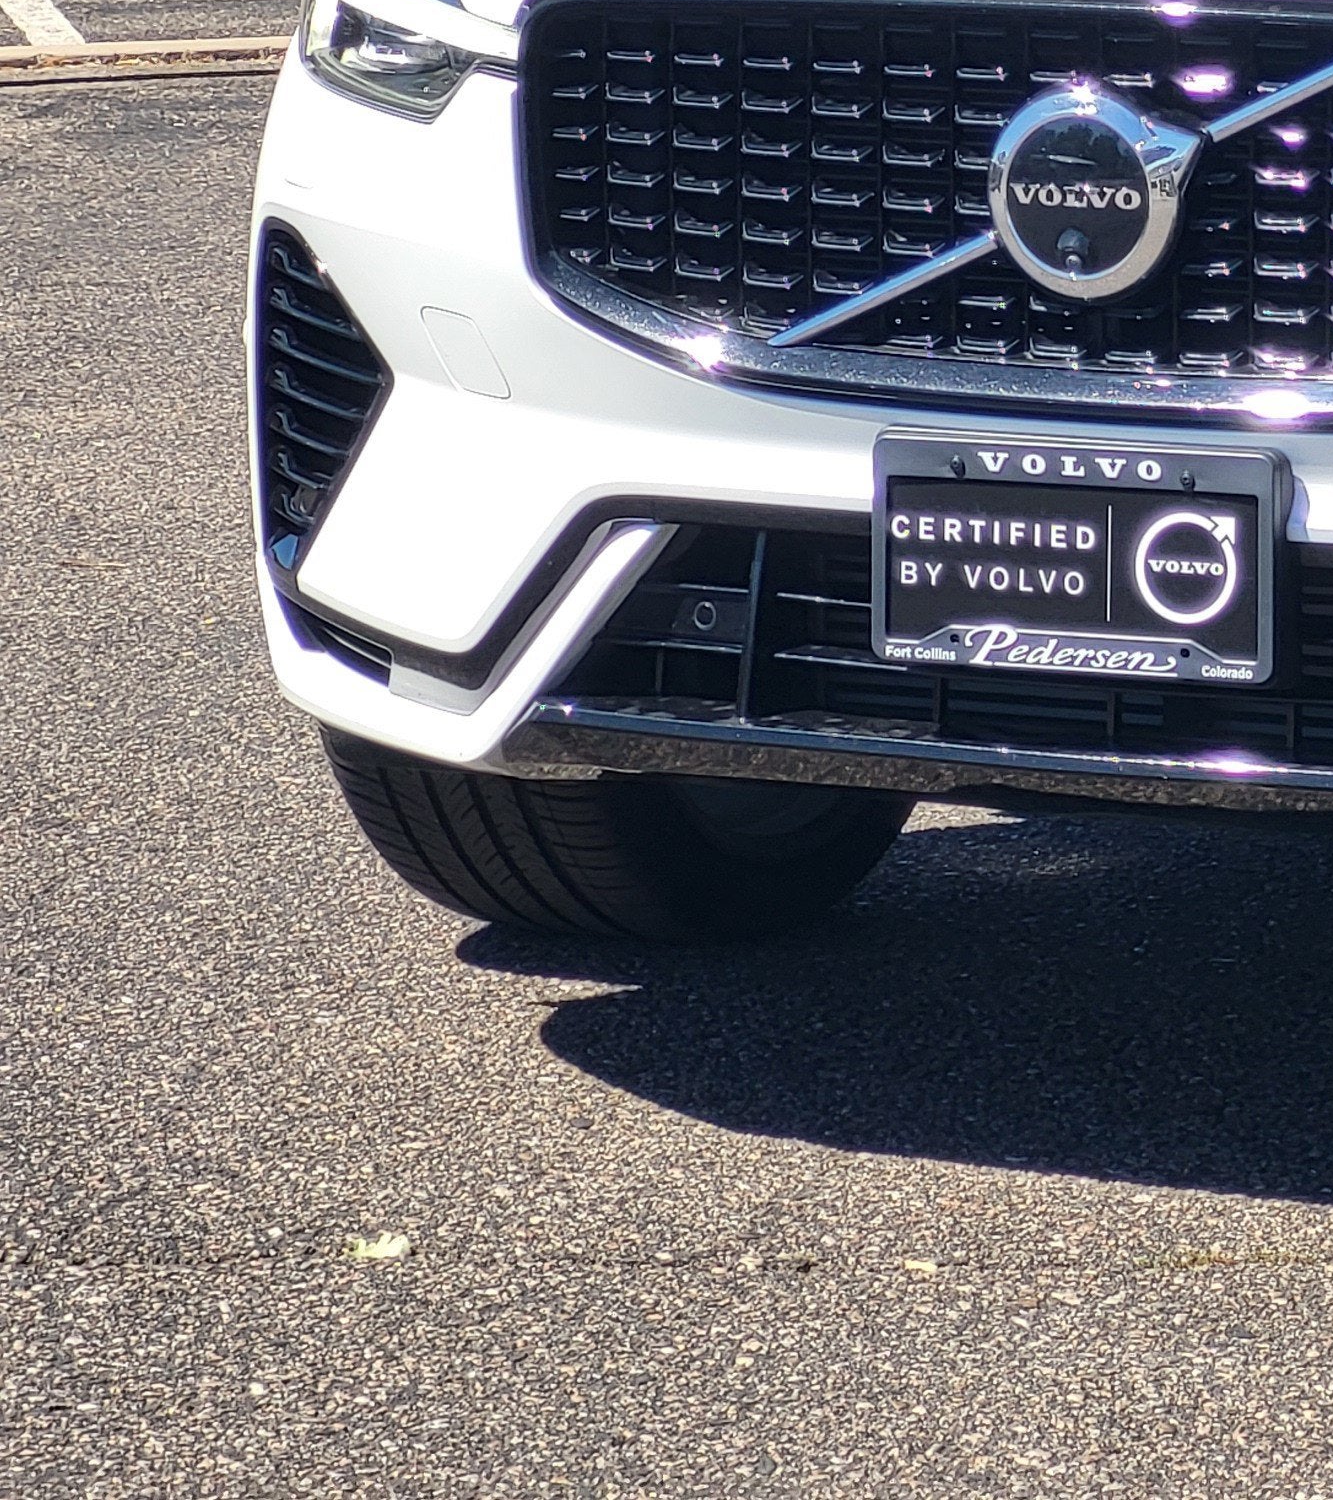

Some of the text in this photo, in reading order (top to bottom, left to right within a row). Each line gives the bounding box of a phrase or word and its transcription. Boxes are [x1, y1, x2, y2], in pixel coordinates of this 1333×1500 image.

[1010, 182, 1142, 210] VOLVO
[977, 451, 1163, 481] VOLVO
[891, 514, 1096, 549] CERTIFIED
[900, 561, 1085, 596] BY VOLVO
[1147, 559, 1225, 576] VOLVO
[884, 645, 957, 662] Fort Collins
[964, 625, 1177, 671] Pedersen
[1201, 665, 1254, 681] Colorado
